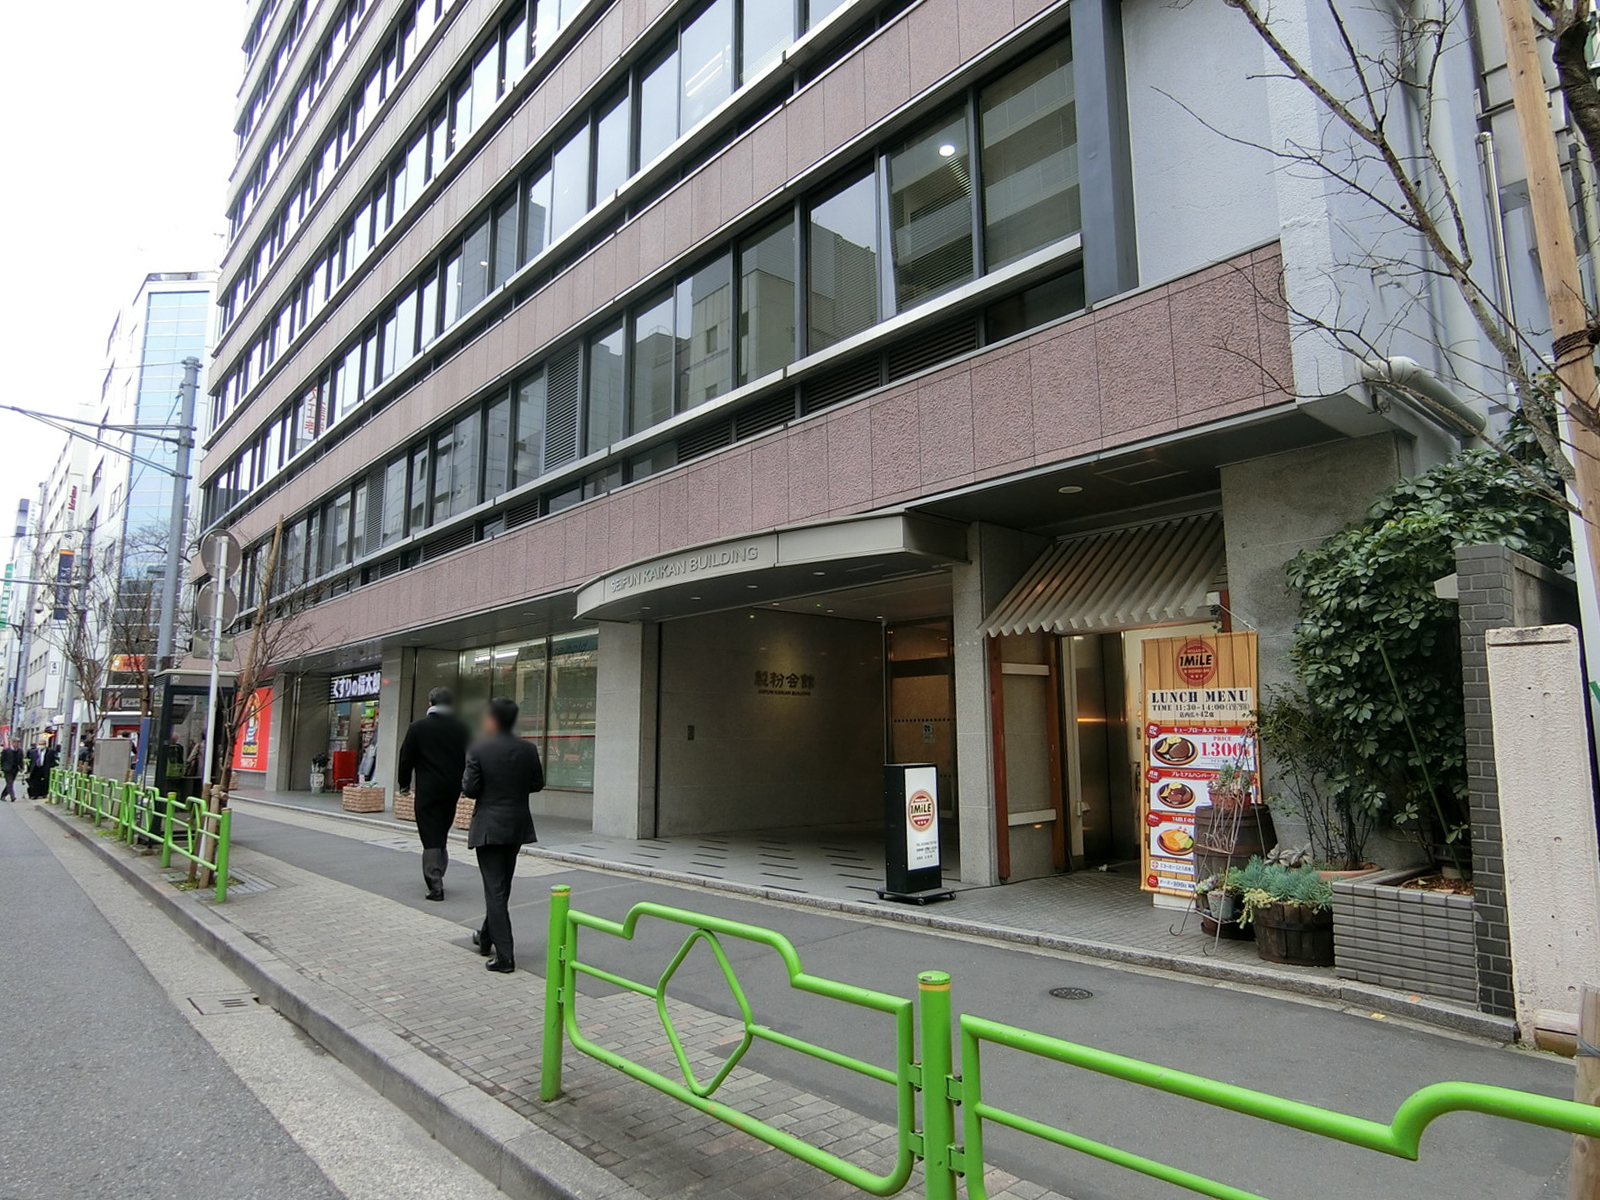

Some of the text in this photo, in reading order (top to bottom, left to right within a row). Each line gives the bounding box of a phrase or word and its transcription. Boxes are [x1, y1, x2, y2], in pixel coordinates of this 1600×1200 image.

[611, 545, 759, 593] SEIFUN KAIKAN BUILDING
[332, 671, 382, 698] くすりの福太郎
[1151, 690, 1249, 704] LUNCH MENU
